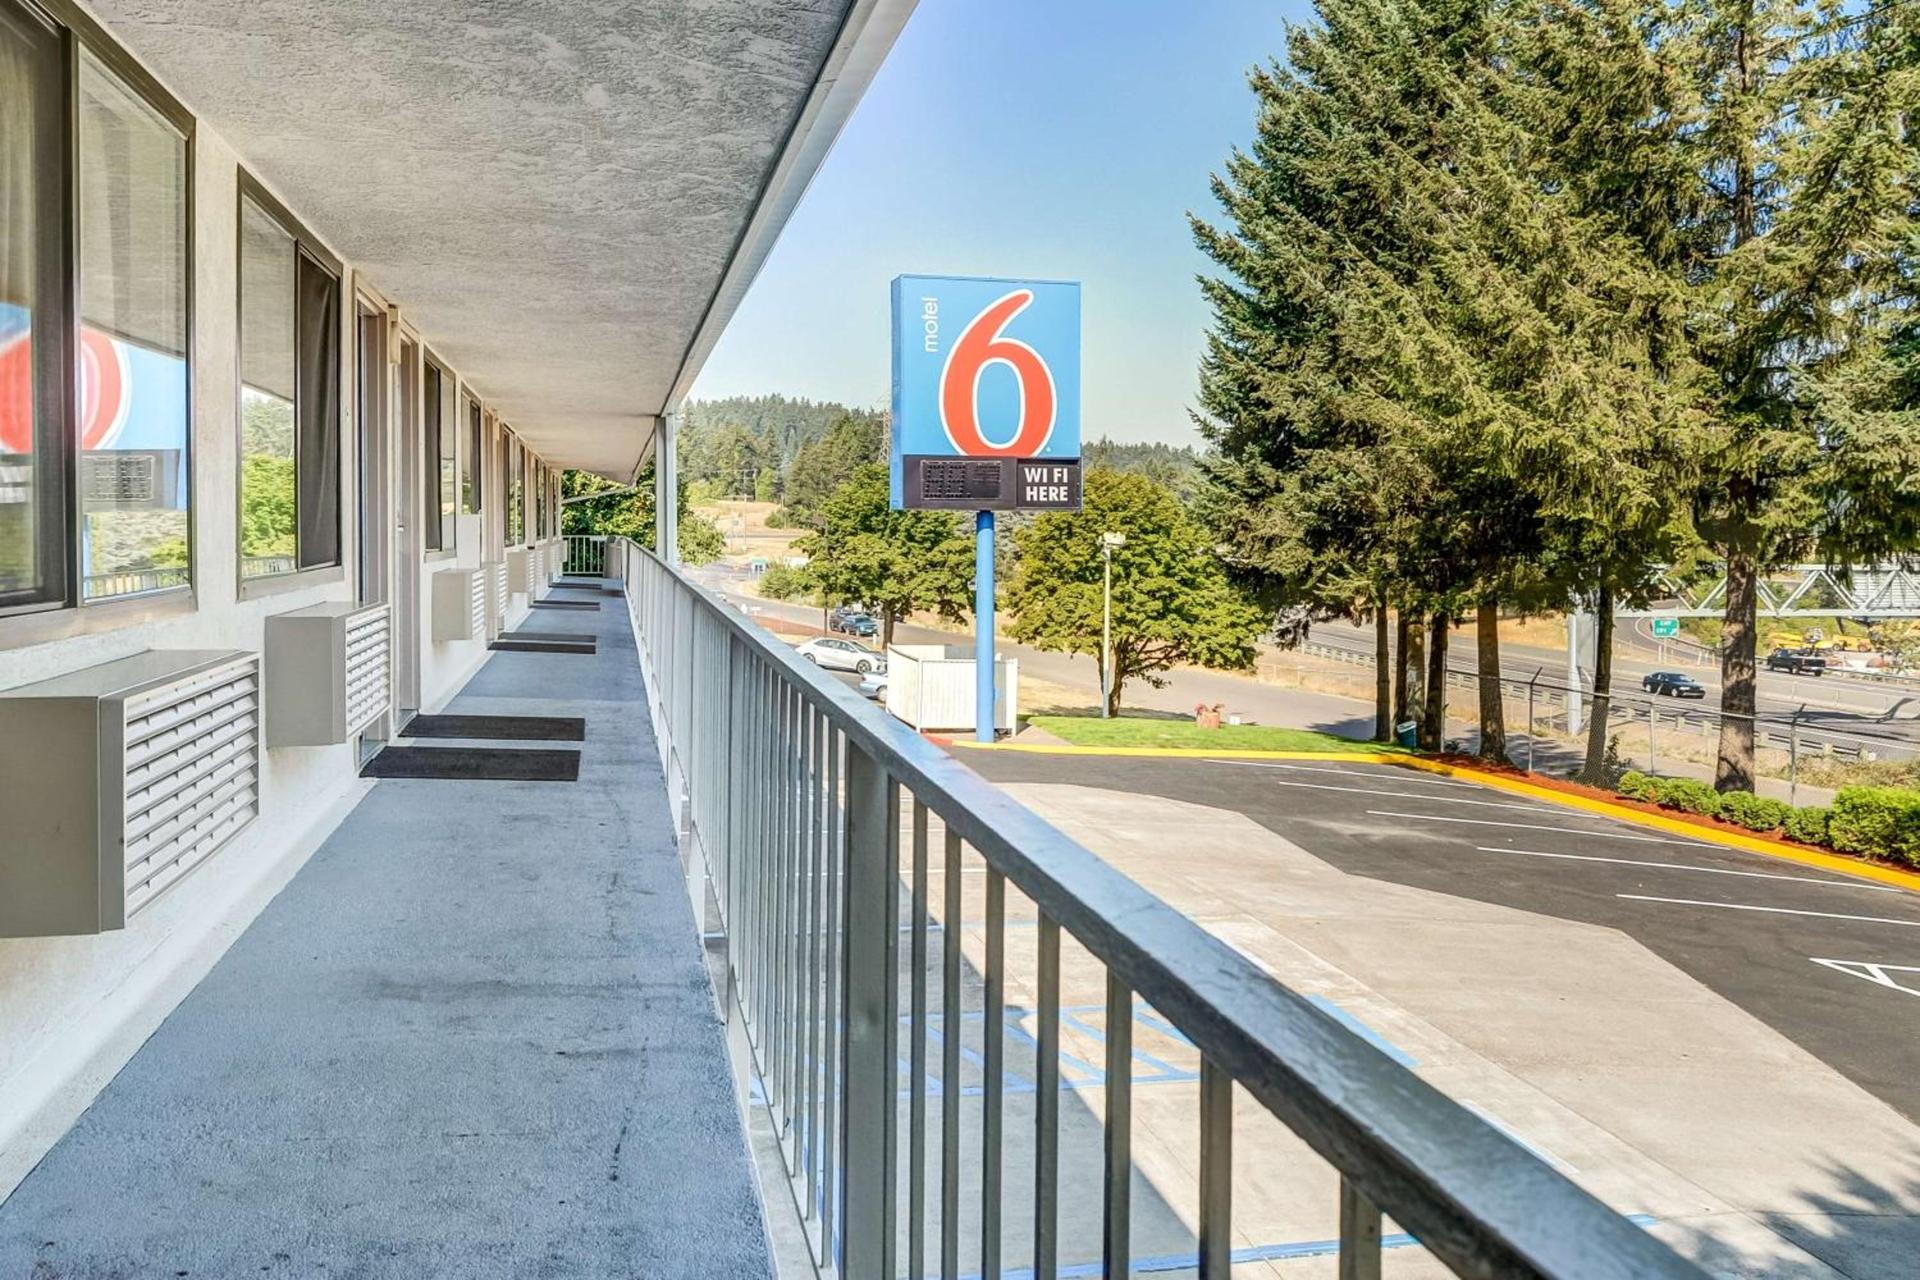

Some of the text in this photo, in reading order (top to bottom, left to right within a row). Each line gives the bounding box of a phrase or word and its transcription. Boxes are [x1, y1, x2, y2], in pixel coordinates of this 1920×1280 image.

[921, 297, 939, 352] motel
[938, 288, 1058, 458] 6
[1024, 467, 1069, 483] WI FI
[1025, 485, 1069, 502] HERE
